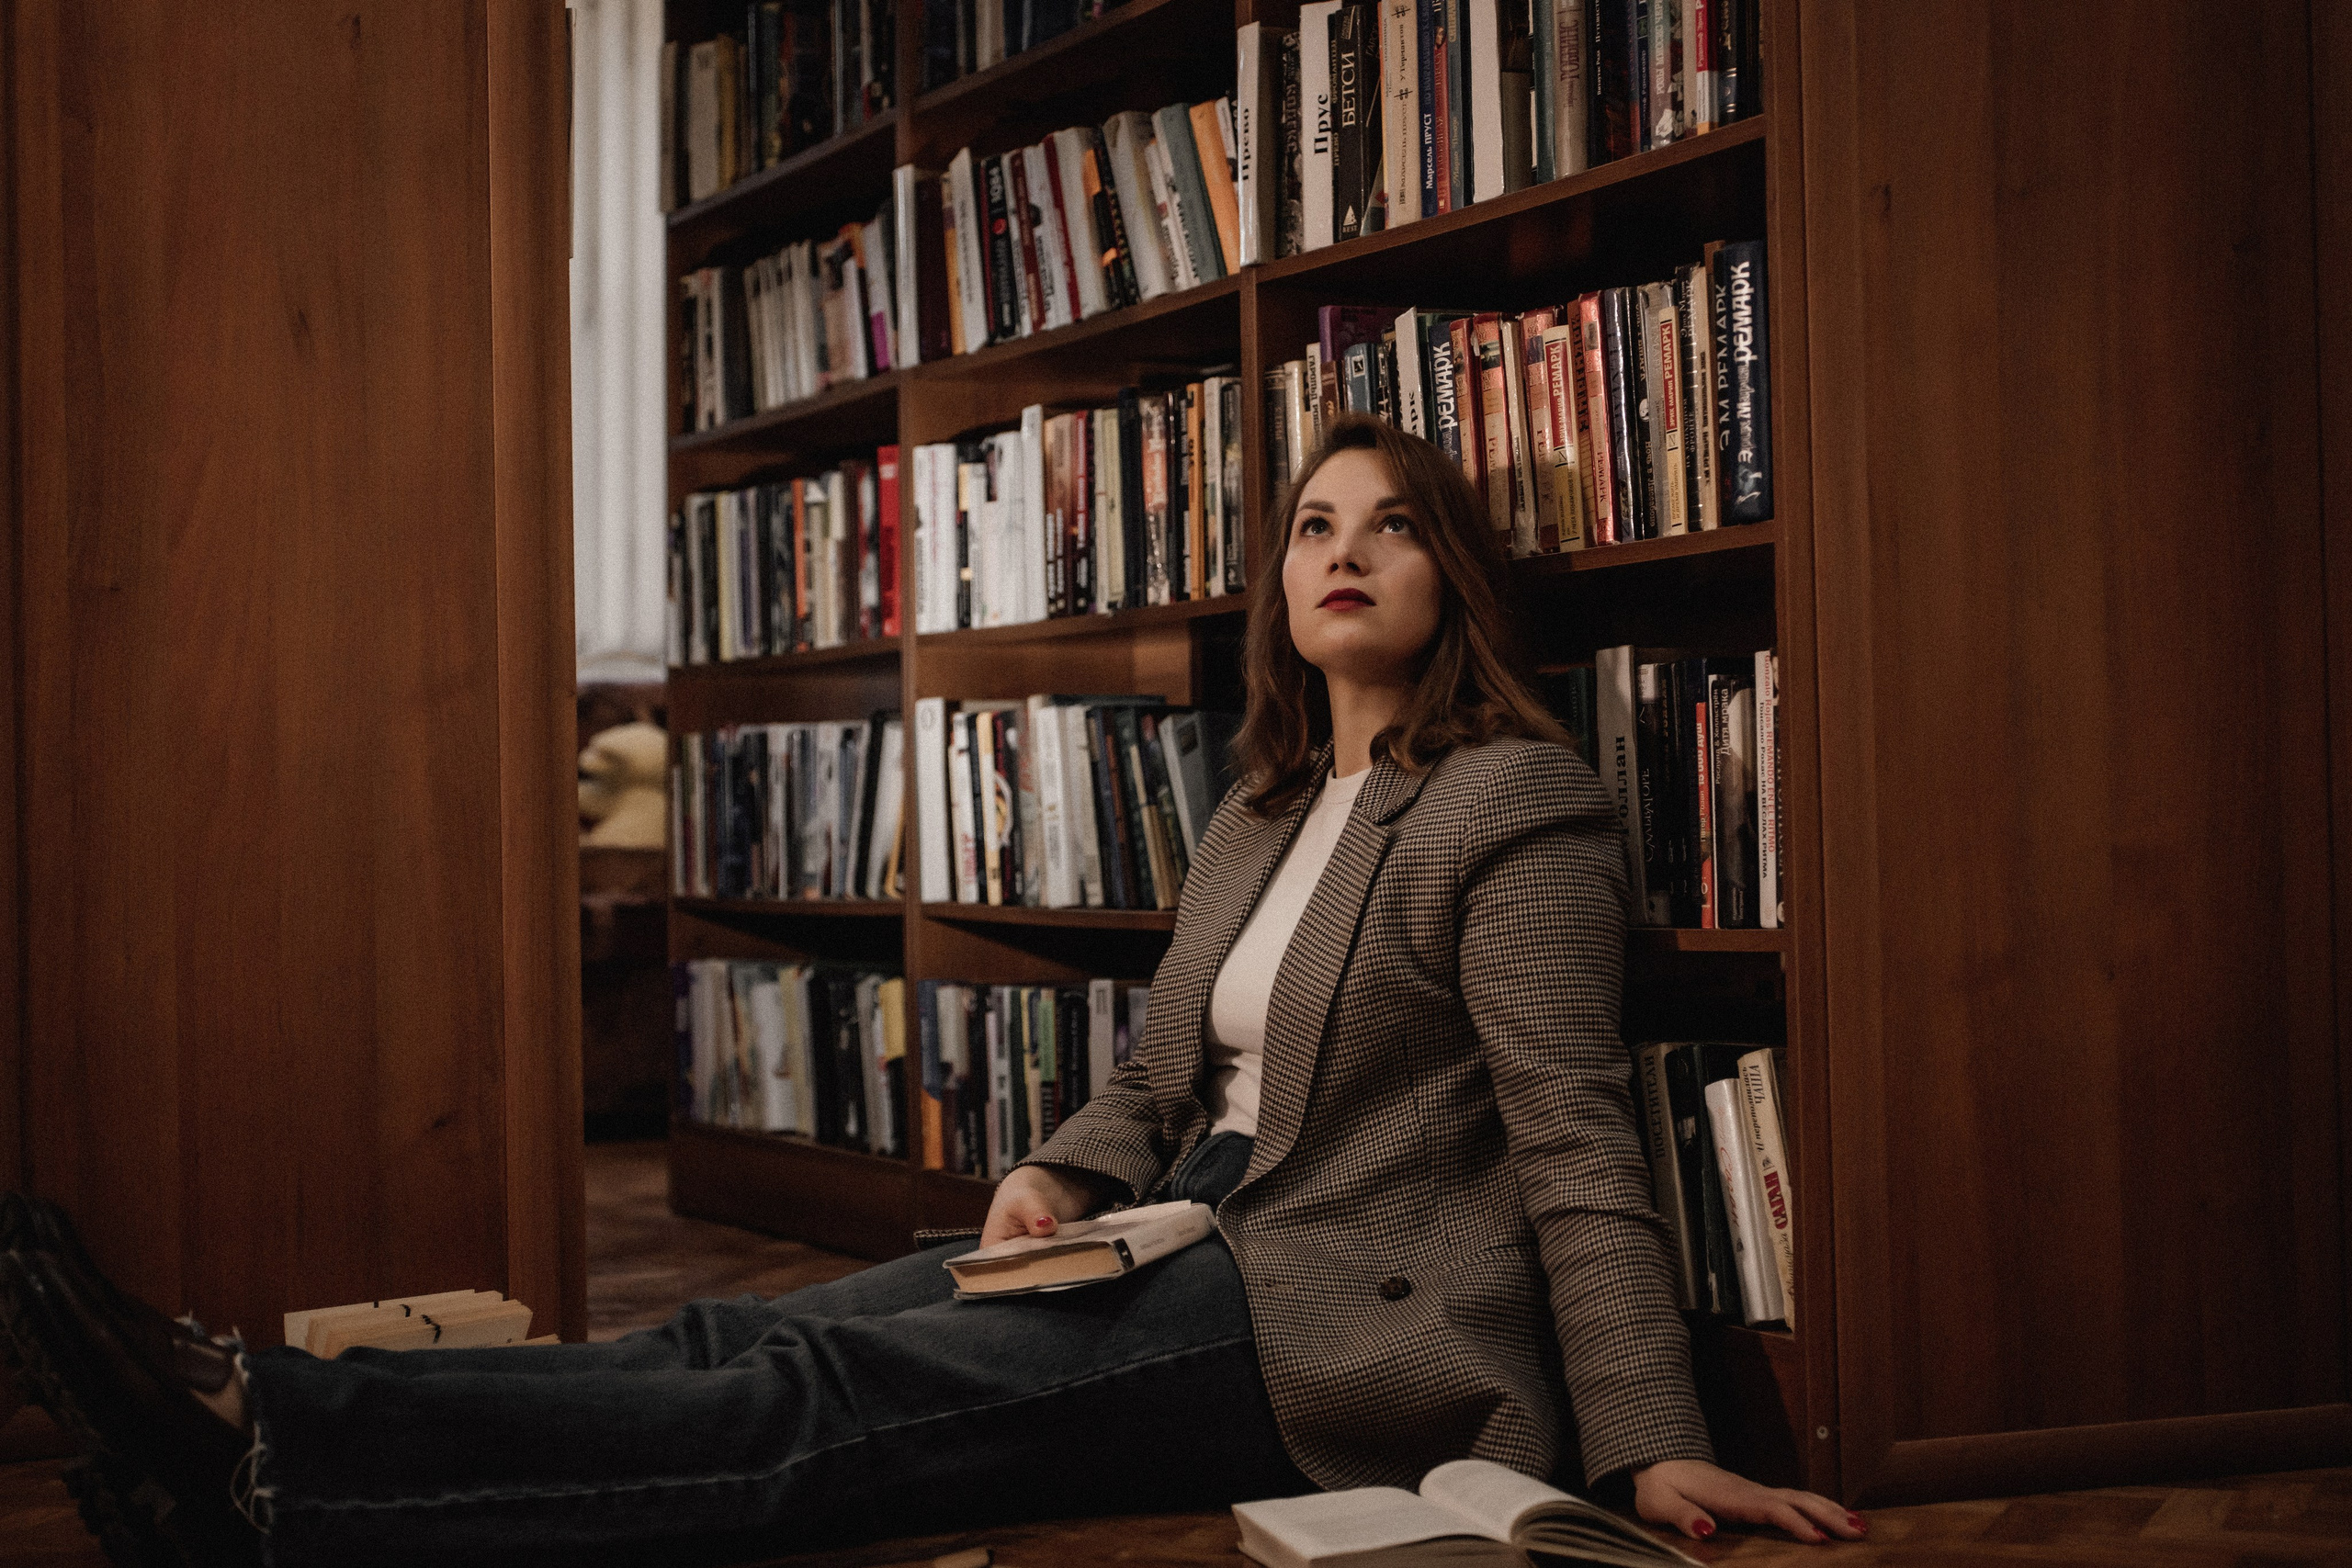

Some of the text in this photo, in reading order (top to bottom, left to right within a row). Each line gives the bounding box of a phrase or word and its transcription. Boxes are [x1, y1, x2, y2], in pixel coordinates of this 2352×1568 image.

[1340, 51, 1356, 128] БЕТСИ
[1313, 92, 1331, 155] Прус
[1423, 113, 1432, 145] ПРУСТ
[1425, 146, 1434, 189] Марсель
[1715, 284, 1729, 390] РЕМАРК
[1730, 260, 1758, 363] РЕМАРК
[1551, 345, 1564, 397] РЕМАРК
[1661, 325, 1673, 378] РЕМАРК
[1432, 342, 1457, 430] РЕМАРК
[1720, 688, 1731, 756] Дитя мрака
[1764, 700, 1772, 728] Rojas
[1765, 730, 1774, 784] REMANDO
[1760, 780, 1767, 795] НА
[1767, 787, 1774, 801] EN
[1768, 804, 1774, 815] EL
[1644, 1055, 1666, 1159] ПОСЕТИТЕЛИ
[1742, 1066, 1761, 1140] переполнилась
[1748, 1065, 1766, 1104] ЧАША
[1763, 1169, 1788, 1230] САГАН
